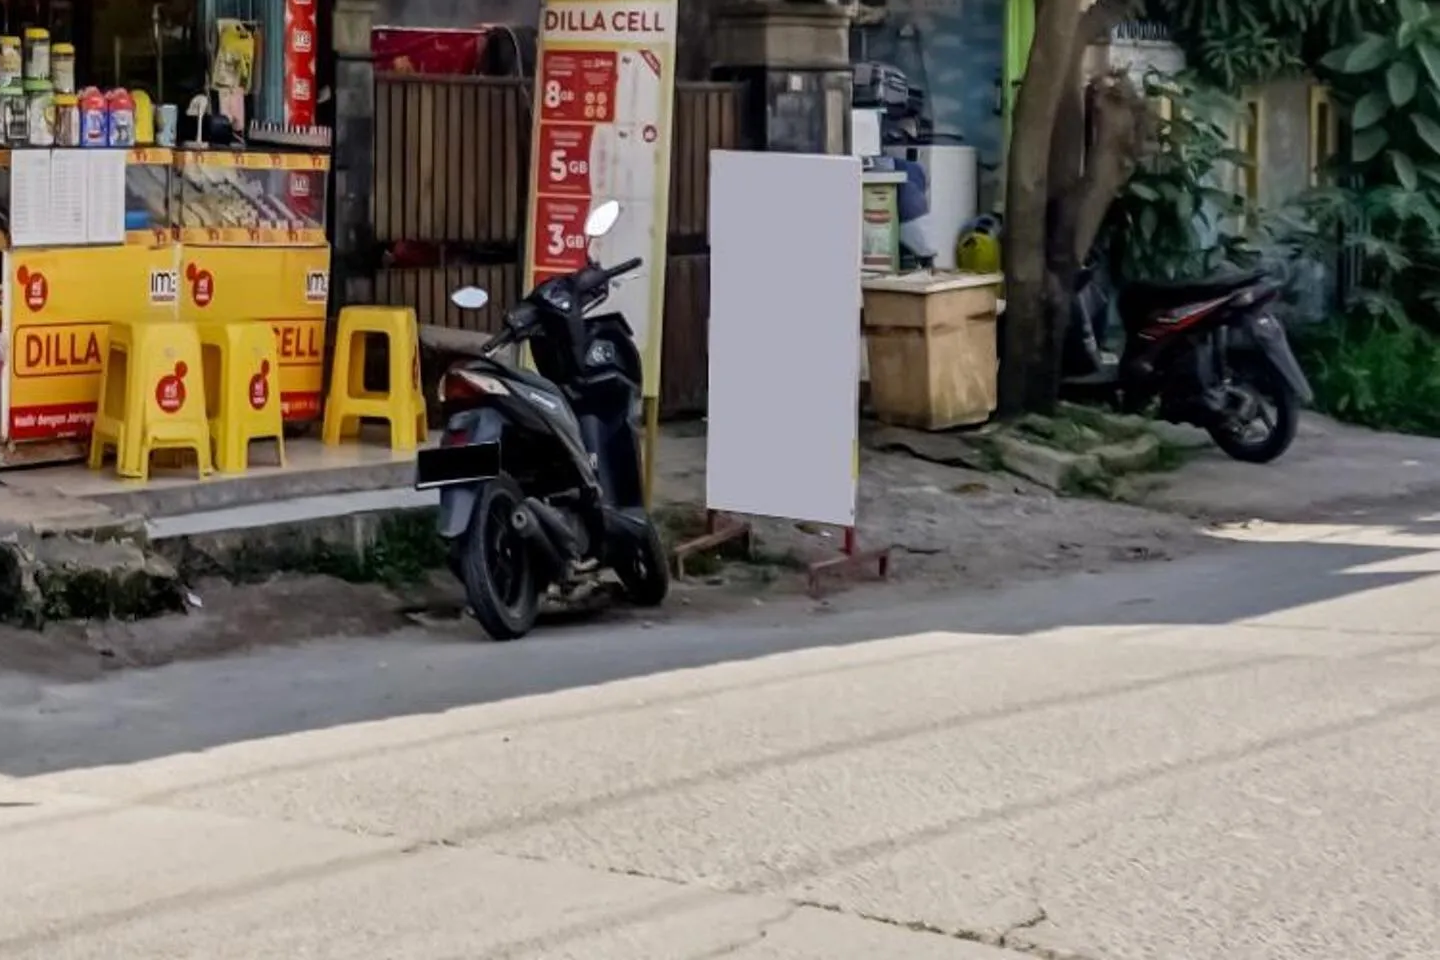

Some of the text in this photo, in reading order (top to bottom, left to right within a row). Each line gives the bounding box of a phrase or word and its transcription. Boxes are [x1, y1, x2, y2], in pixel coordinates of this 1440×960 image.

[544, 9, 665, 32] DILLA CELL
[549, 149, 589, 181] 5 GB
[547, 223, 586, 256] 3 GB
[26, 330, 102, 367] DILLA
